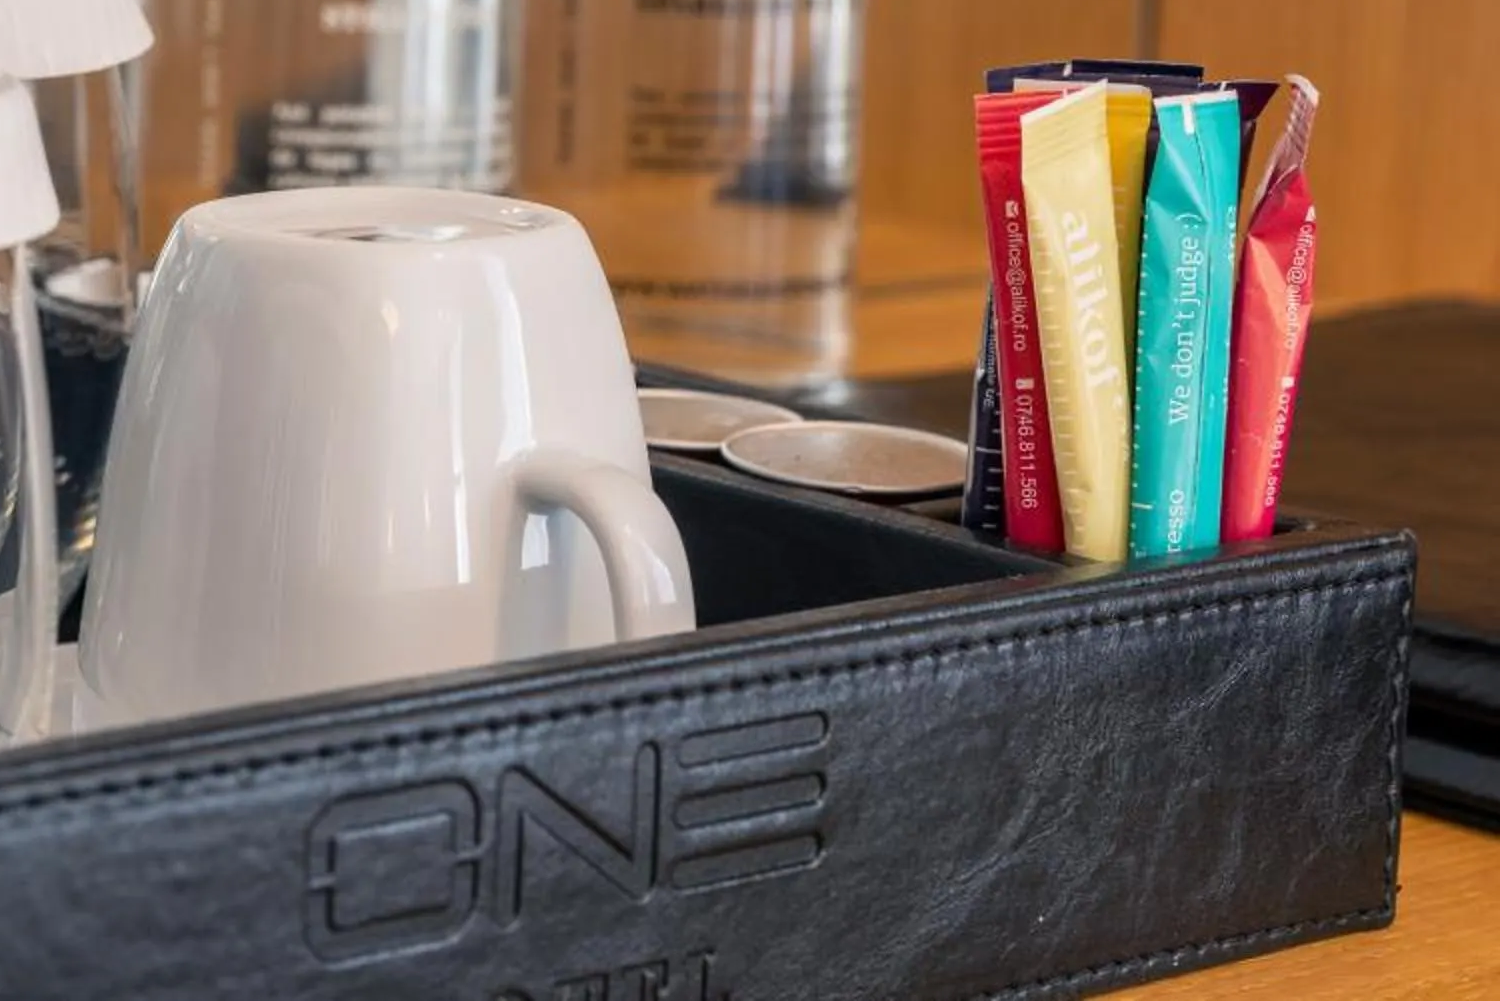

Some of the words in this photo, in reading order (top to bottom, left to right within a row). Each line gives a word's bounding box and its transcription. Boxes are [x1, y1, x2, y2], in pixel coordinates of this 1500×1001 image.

[1005, 221, 1029, 353] office@alikof.ro
[1062, 211, 1119, 388] alikof
[1174, 235, 1204, 307] judge
[1015, 395, 1038, 509] 0746.811.566
[1168, 386, 1191, 426] We
[302, 709, 830, 972] ONE
